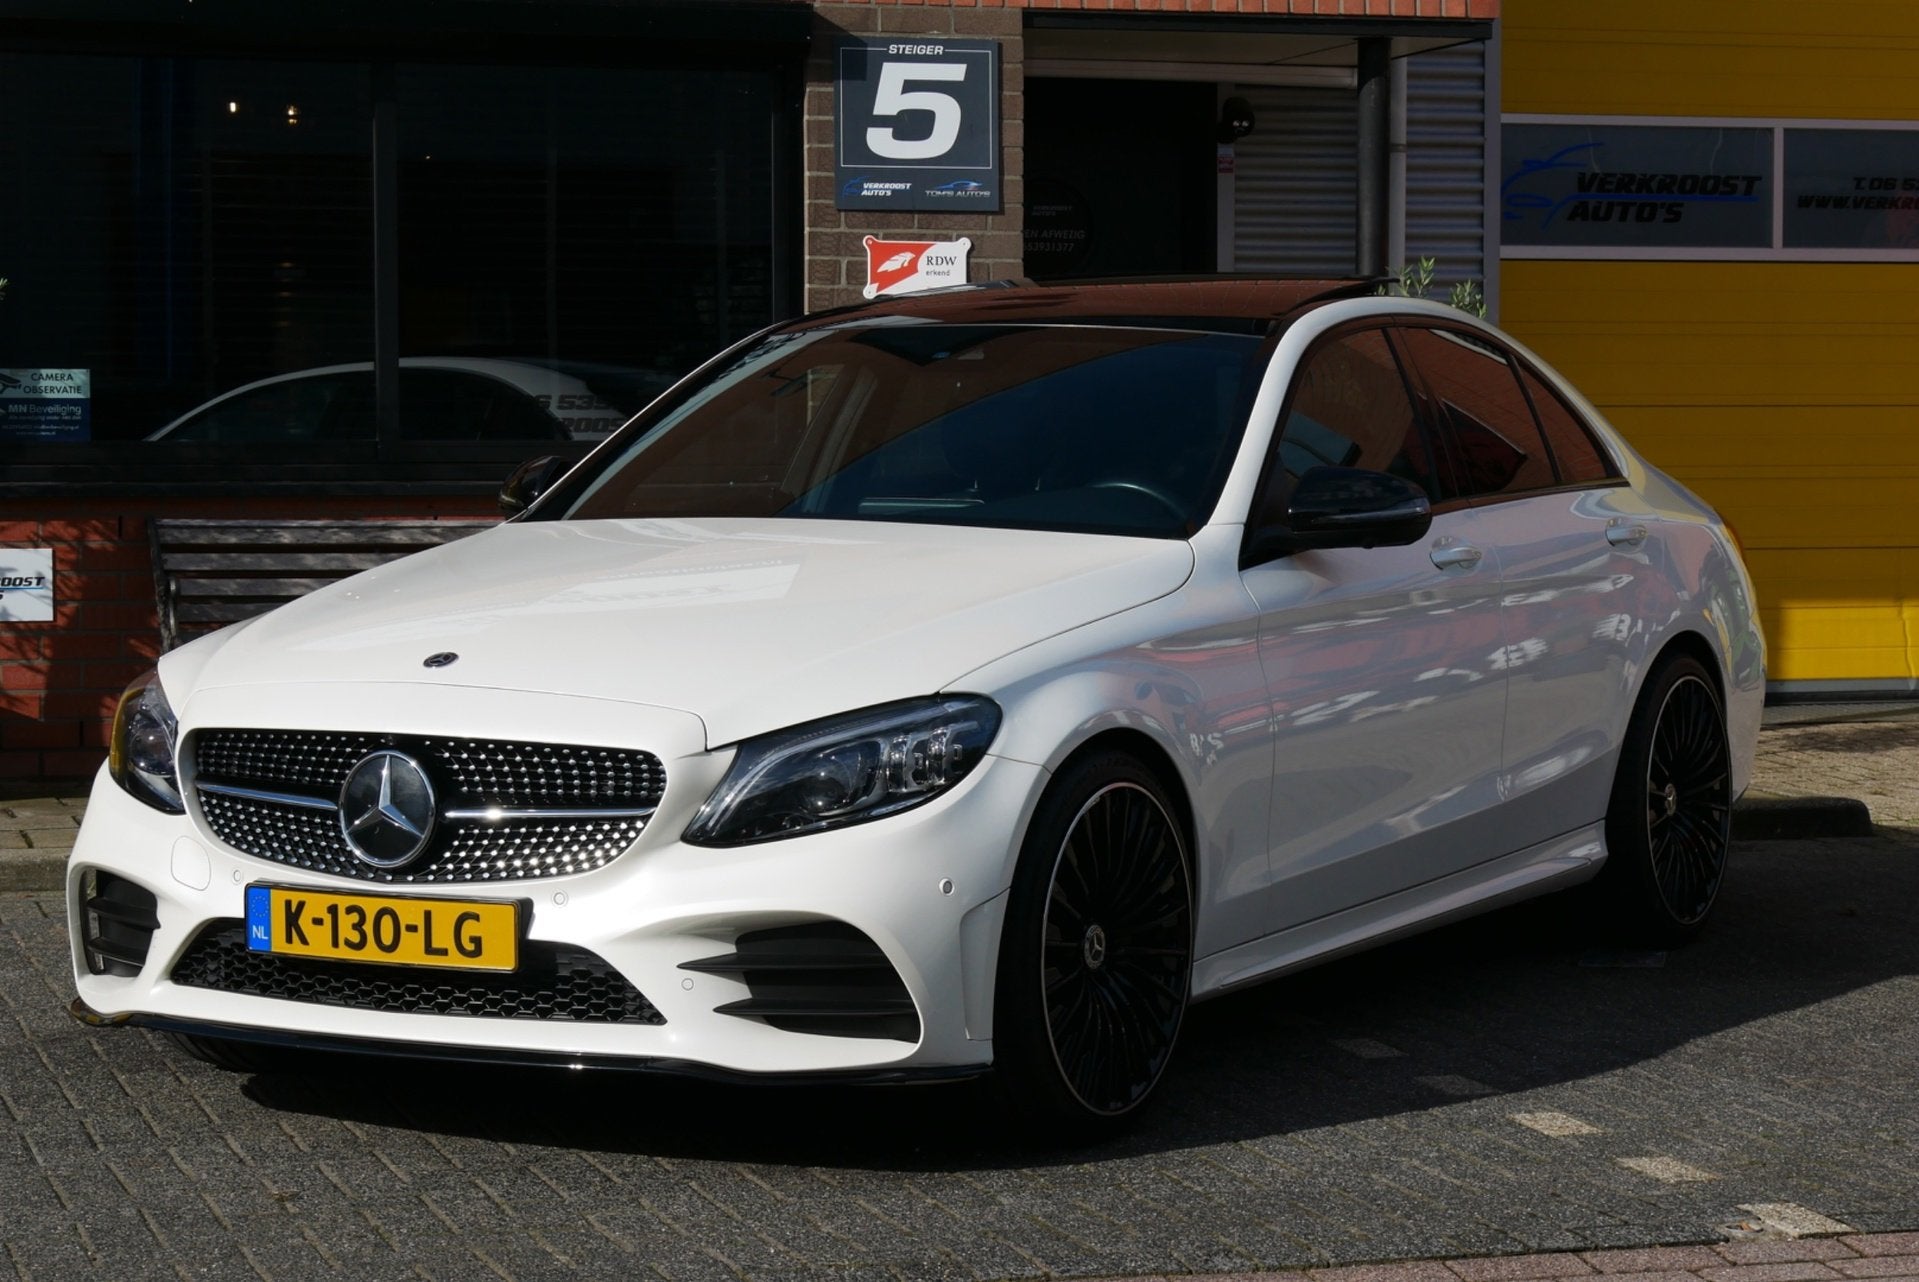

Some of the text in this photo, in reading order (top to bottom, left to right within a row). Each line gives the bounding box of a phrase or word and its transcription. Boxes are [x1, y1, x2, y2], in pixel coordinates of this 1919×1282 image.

[888, 44, 944, 56] STEIGER
[866, 62, 967, 159] 5
[863, 182, 912, 190] VERKROOST
[1576, 172, 1762, 196] VERKROOST
[861, 189, 892, 197] AUTO'S
[1567, 201, 1685, 223] AUTO'S
[1041, 229, 1086, 240] AFWEZIG
[1024, 241, 1075, 253] 53931377
[926, 255, 957, 266] RDW
[926, 269, 950, 277] erkend
[31, 373, 74, 382] CAMERA
[23, 385, 82, 394] OBSERVATIE
[8, 403, 82, 416] MN Beveiliging
[252, 925, 269, 940] NL
[284, 899, 483, 959] K-130-LG
